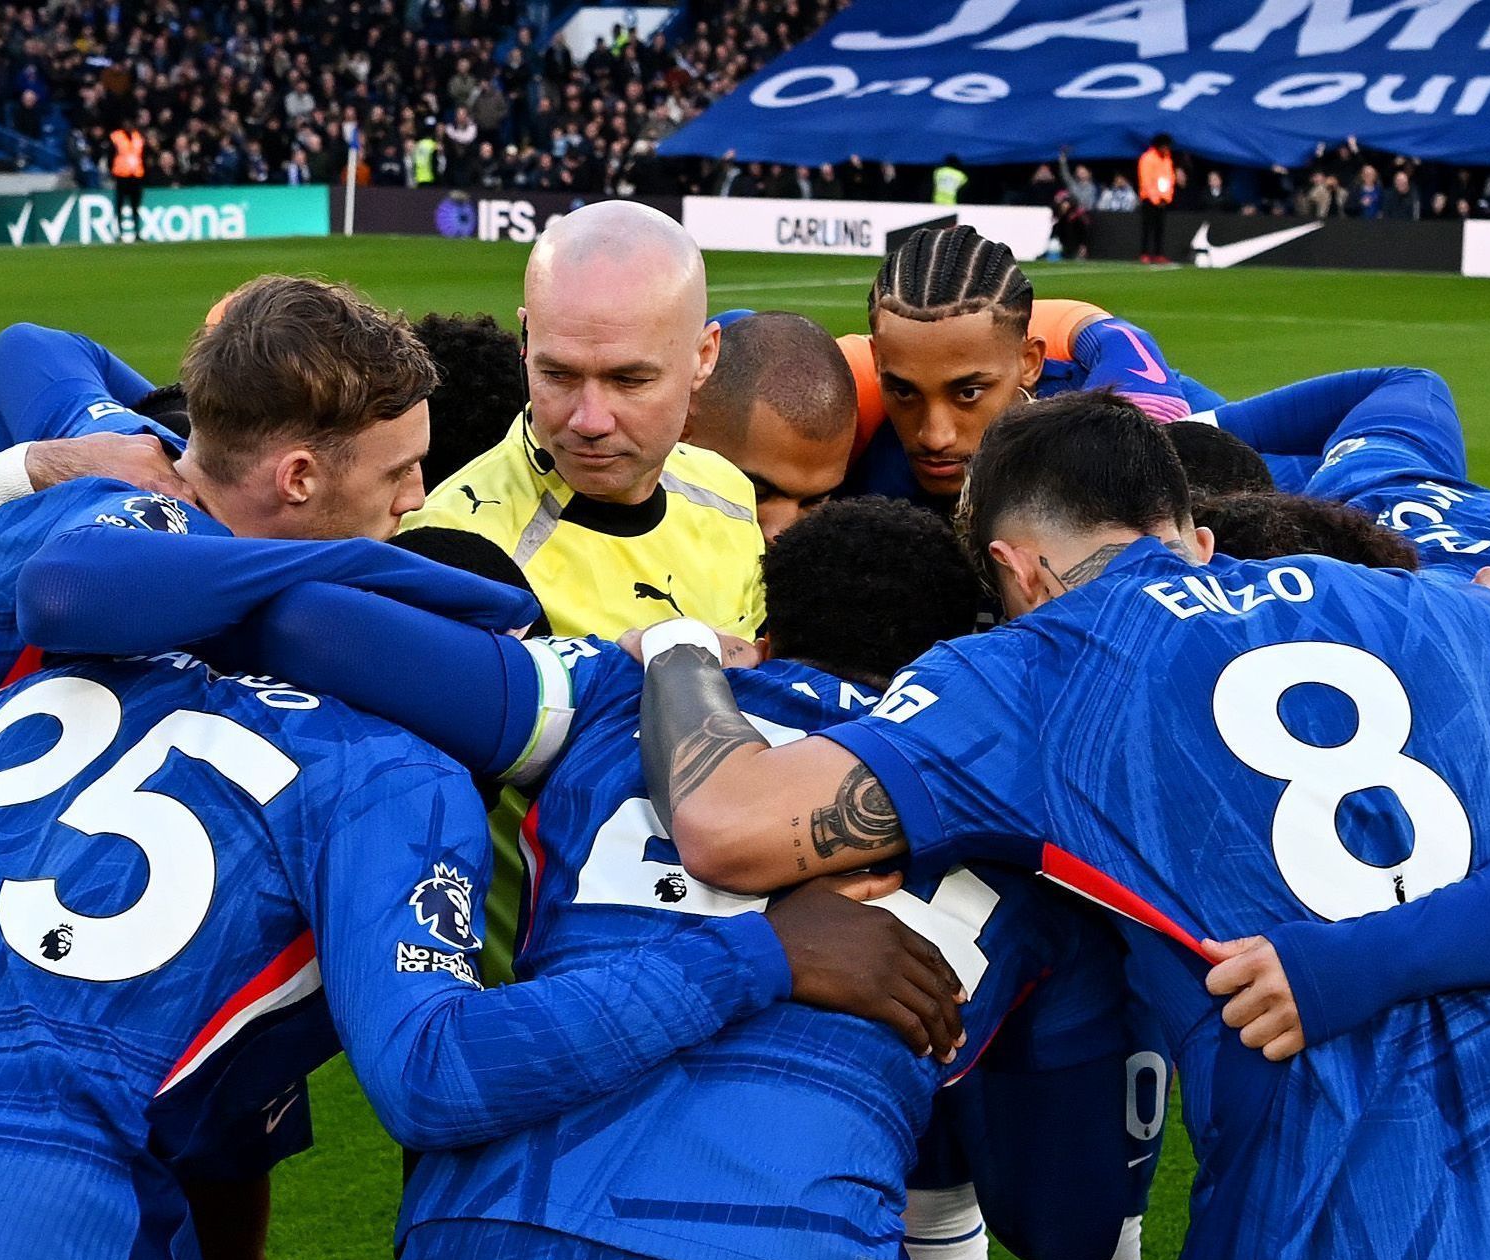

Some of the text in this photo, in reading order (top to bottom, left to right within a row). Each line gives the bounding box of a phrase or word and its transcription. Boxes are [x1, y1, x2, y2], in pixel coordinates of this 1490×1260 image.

[749, 65, 1010, 108] One
[1055, 63, 1235, 111] Of
[477, 198, 551, 243] IFS.
[776, 216, 872, 248] CARLING
[1141, 565, 1315, 621] ENZO
[1211, 640, 1474, 924] 8
[396, 941, 430, 960] No
